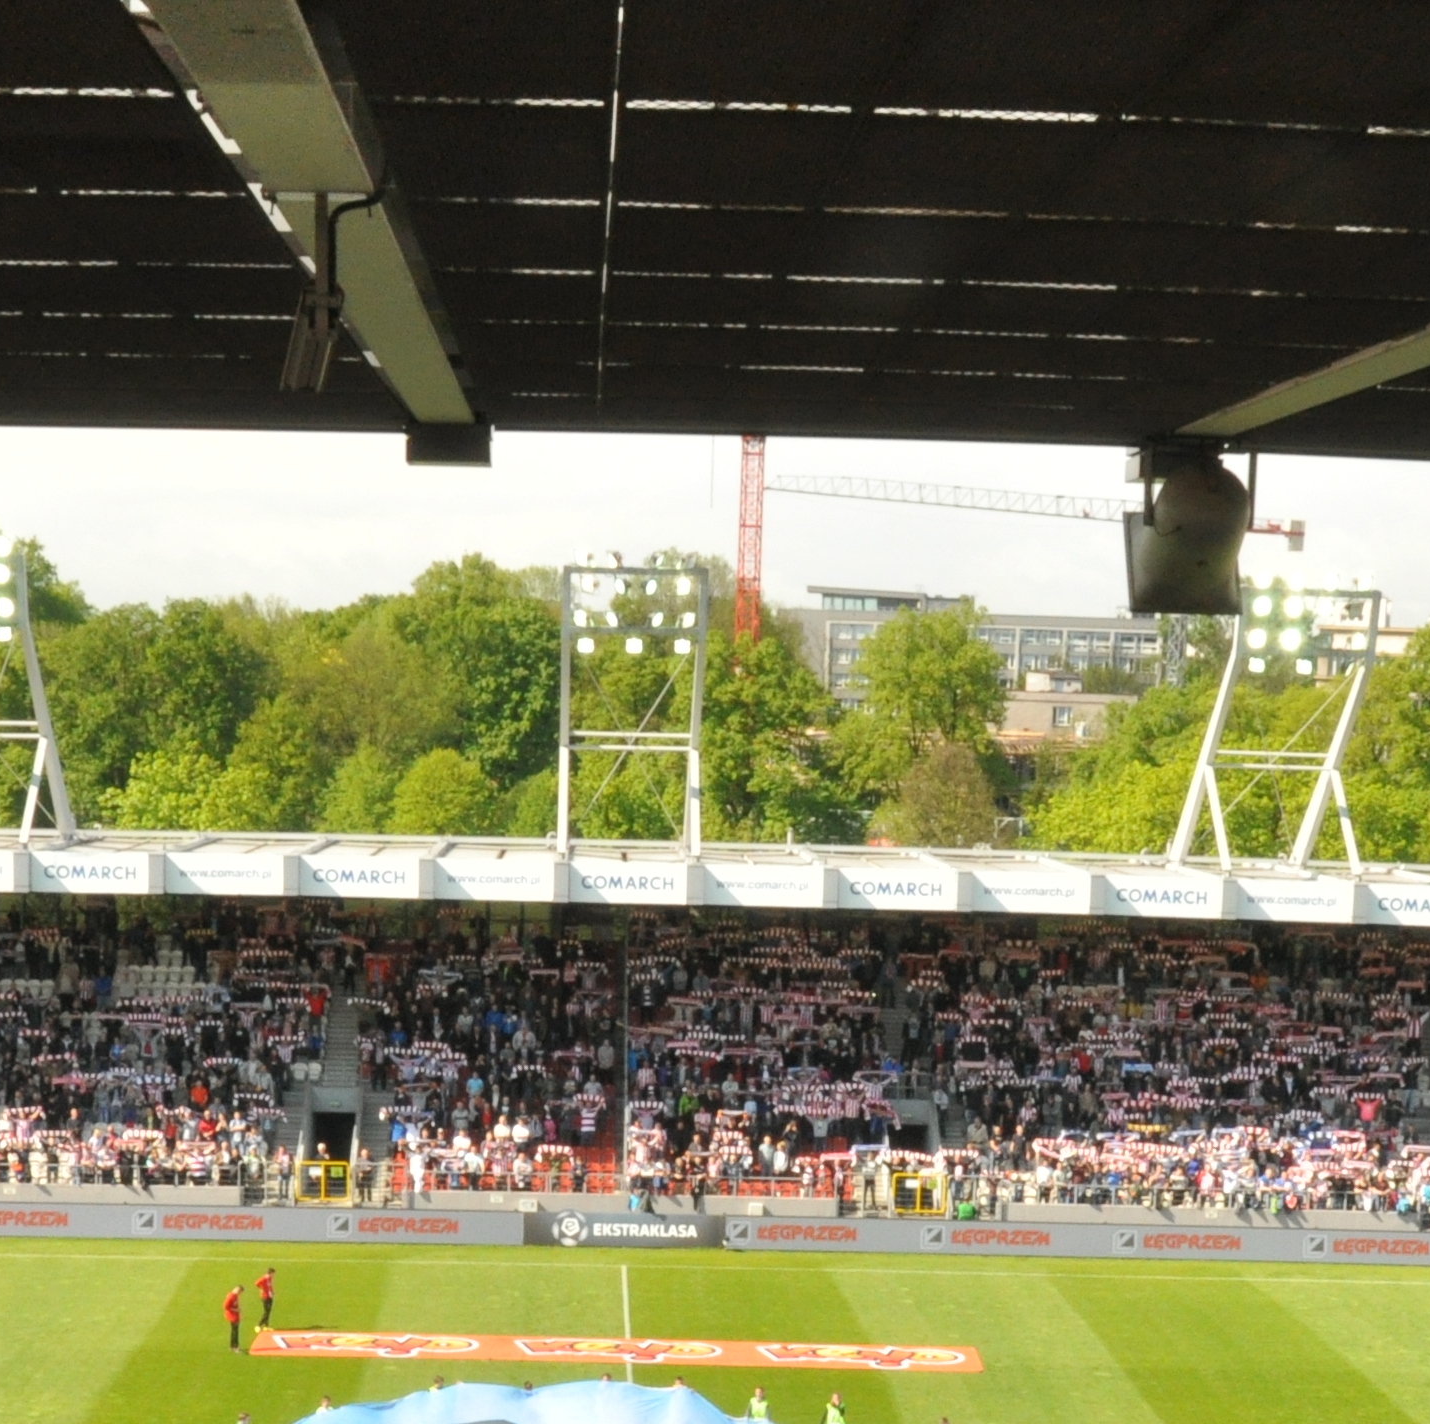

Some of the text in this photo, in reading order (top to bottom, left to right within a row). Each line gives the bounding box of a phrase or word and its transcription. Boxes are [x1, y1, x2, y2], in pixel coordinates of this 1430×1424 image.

[44, 864, 136, 880] COMARCH
[313, 868, 405, 884] COMARCH
[581, 875, 674, 891] COMARCH
[850, 881, 942, 897] COMARCH
[1116, 888, 1207, 905] COMARCH
[593, 1223, 697, 1239] EKSTRAKLASA
